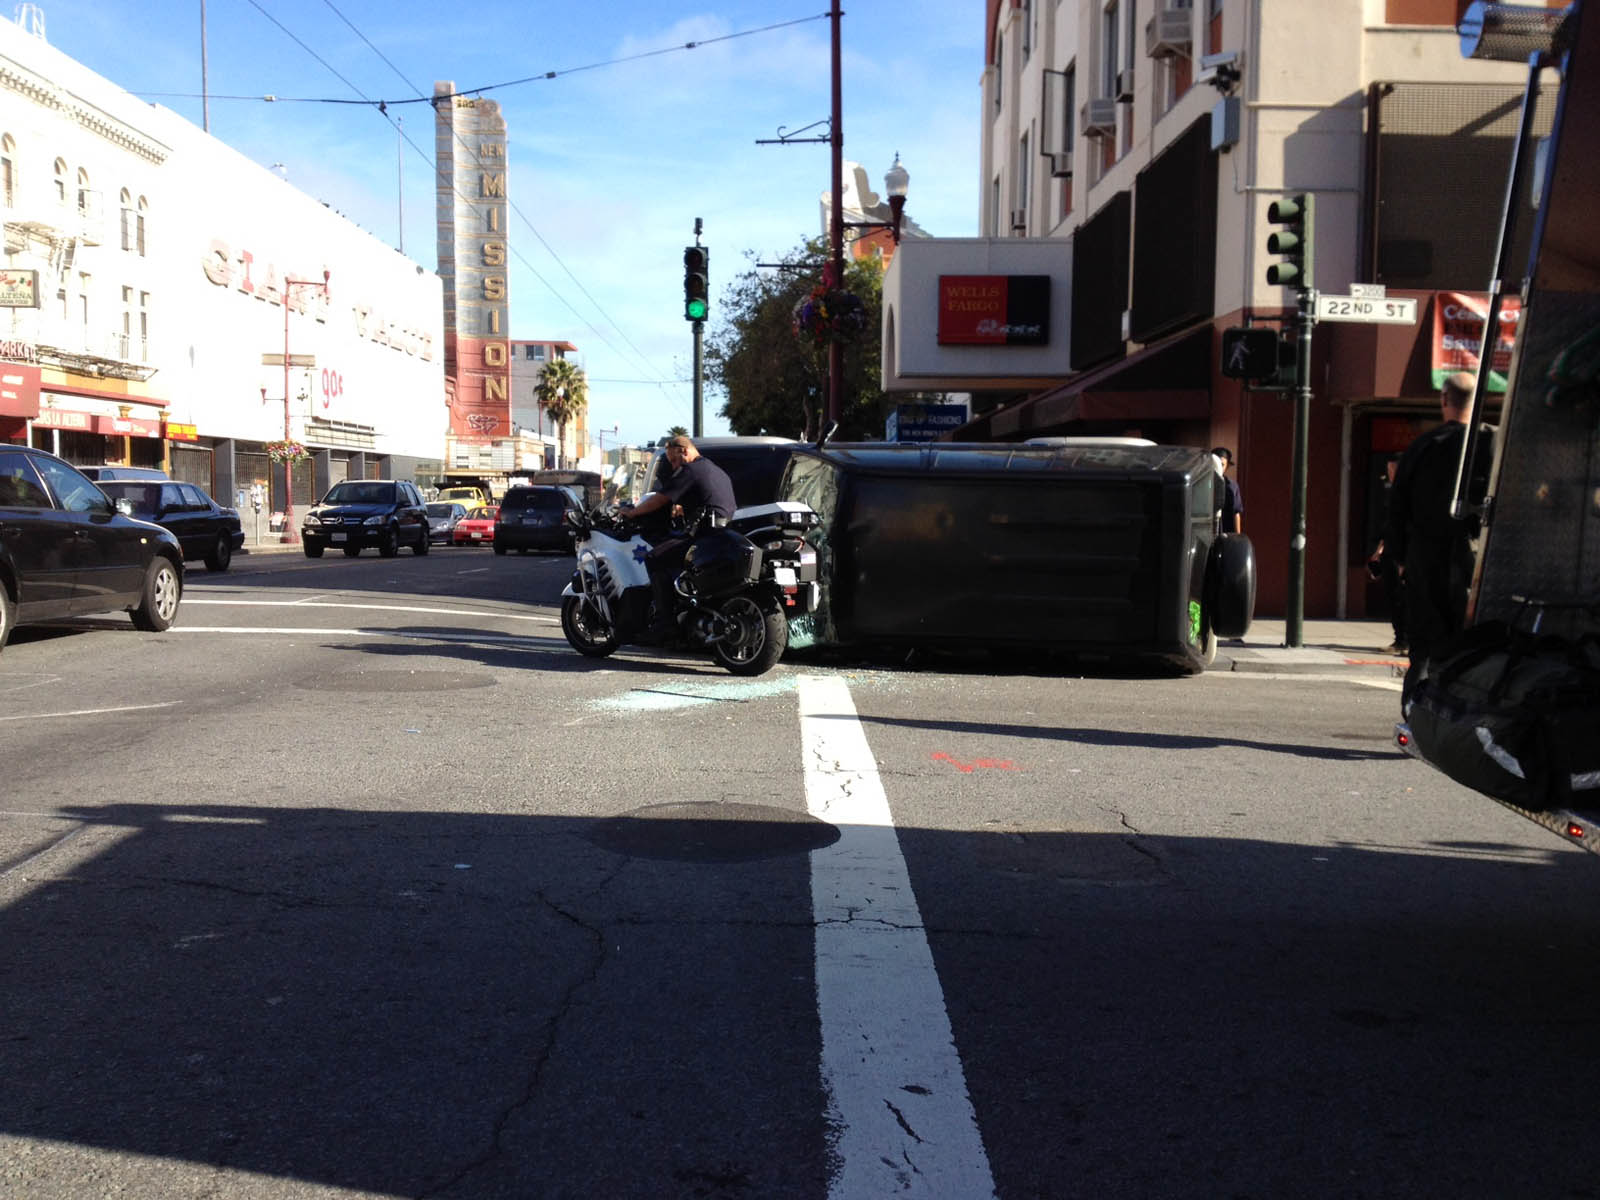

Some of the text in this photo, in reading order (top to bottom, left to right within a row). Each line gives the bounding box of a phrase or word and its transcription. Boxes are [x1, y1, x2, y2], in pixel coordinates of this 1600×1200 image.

[480, 172, 508, 401] MISSION
[946, 286, 1000, 298] WELLS
[947, 301, 1000, 312] FARGO
[1328, 301, 1406, 317] 22ND ST
